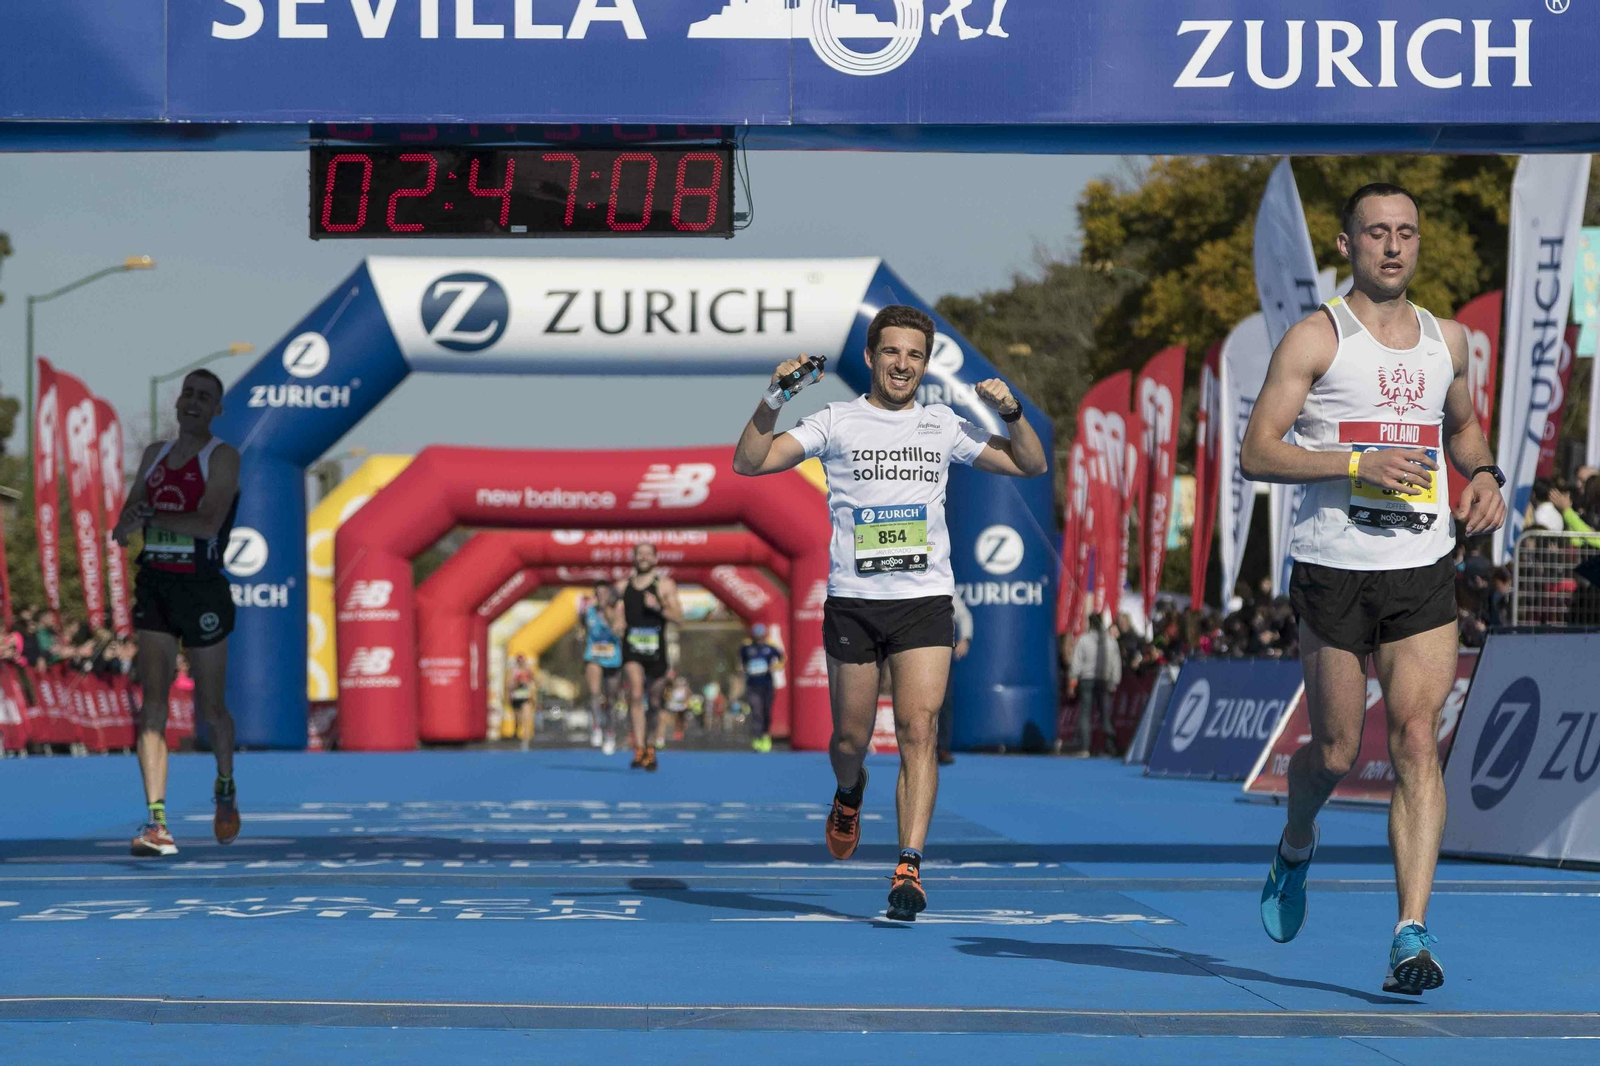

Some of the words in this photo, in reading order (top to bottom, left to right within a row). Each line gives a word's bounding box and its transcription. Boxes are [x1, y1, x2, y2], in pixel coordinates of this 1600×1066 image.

[1174, 18, 1532, 89] ZURICH
[321, 152, 722, 232] 02:47:08
[544, 289, 796, 334] ZURICH
[248, 384, 350, 409] ZURICH
[1379, 424, 1420, 443] POLAND
[852, 447, 941, 464] zapatillas
[853, 465, 940, 483] solidarias
[476, 488, 522, 507] new
[524, 486, 617, 509] balance
[877, 508, 919, 520] ZURICH
[878, 529, 907, 545] 854
[229, 583, 288, 608] RICH
[1538, 712, 1600, 783] ZU
